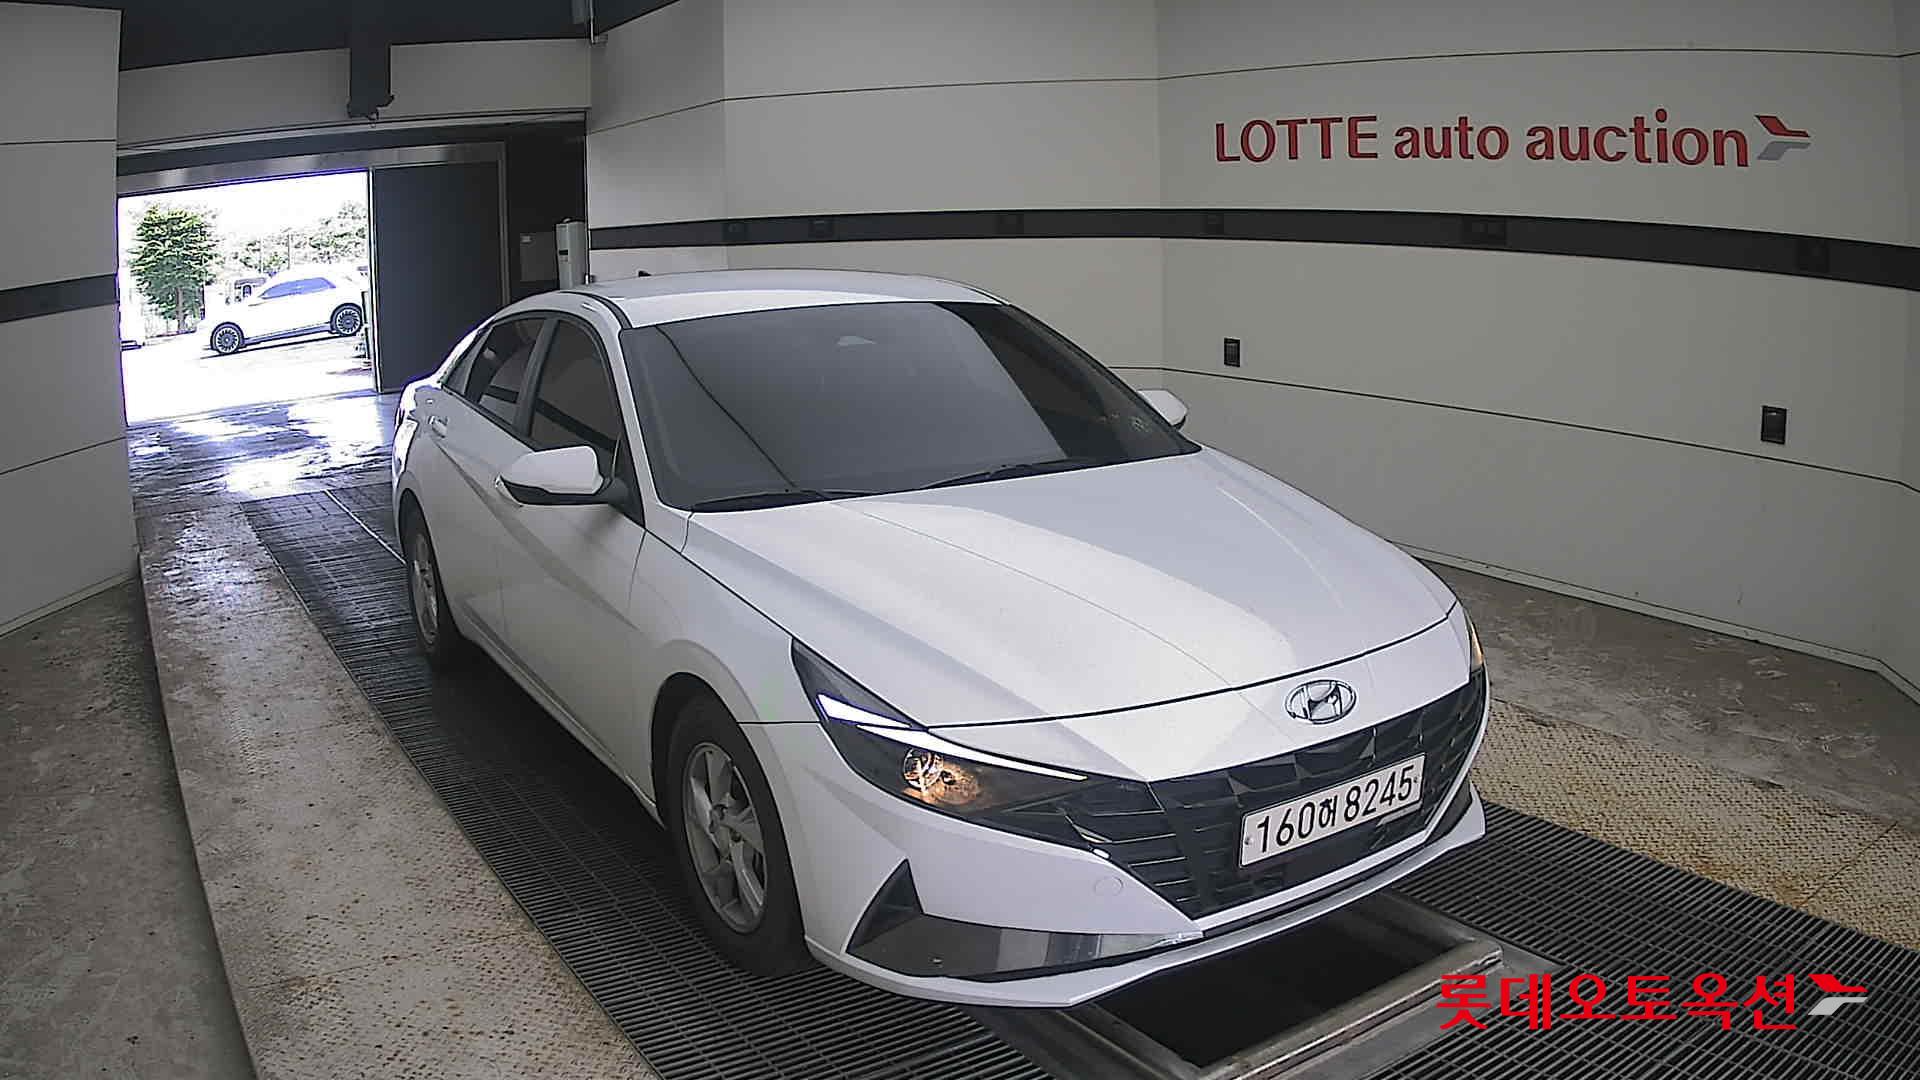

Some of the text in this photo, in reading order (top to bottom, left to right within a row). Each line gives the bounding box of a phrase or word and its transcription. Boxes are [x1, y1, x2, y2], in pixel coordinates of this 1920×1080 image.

[1215, 109, 1748, 167] LOTTE auto auction
[1344, 765, 1414, 822] 8245
